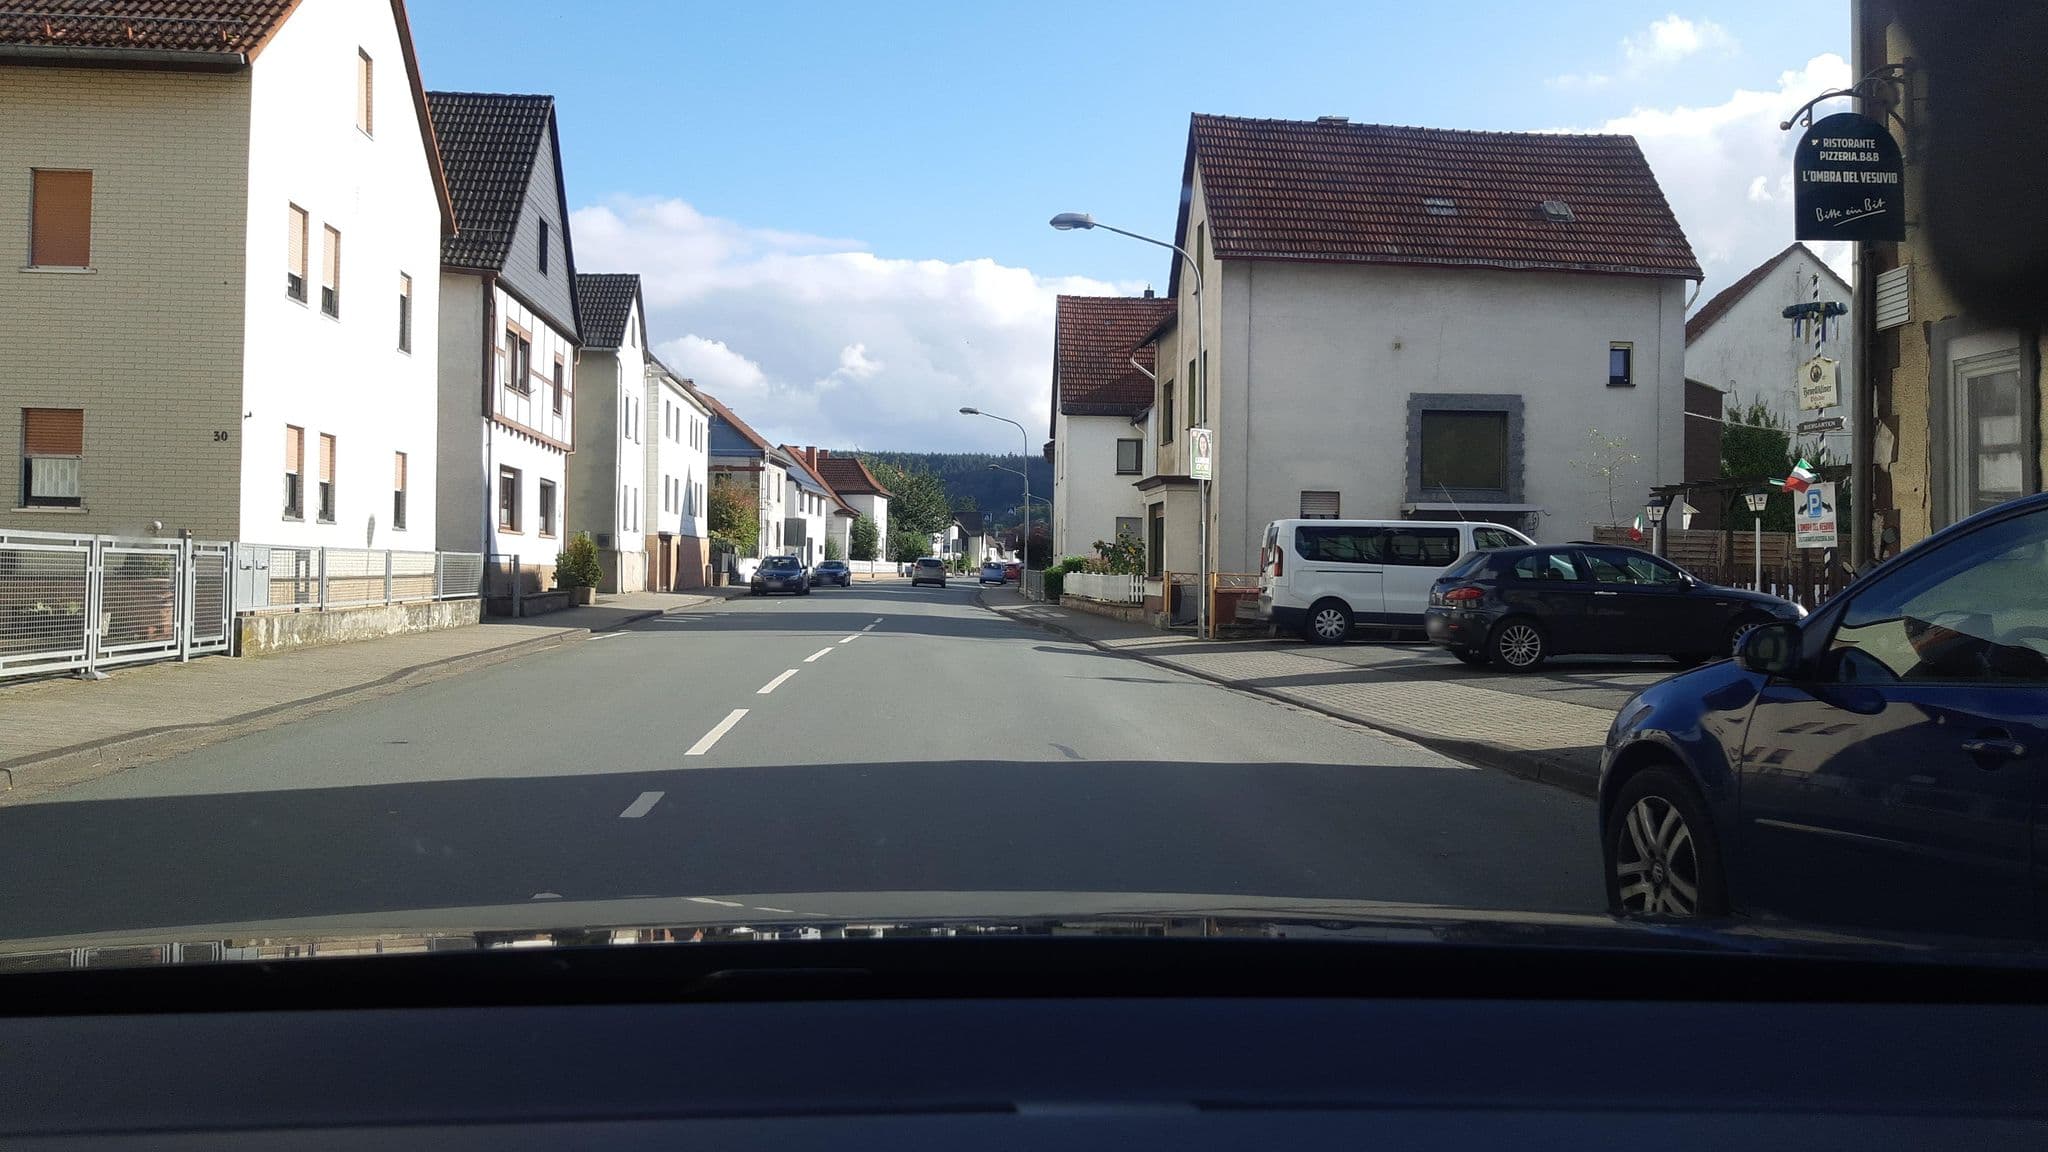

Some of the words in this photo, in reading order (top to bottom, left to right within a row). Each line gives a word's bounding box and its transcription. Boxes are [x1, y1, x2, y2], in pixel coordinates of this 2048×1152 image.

[1823, 138, 1876, 149] RISTORANTE
[1802, 170, 1842, 183] L'OMBRA
[1843, 171, 1859, 183] DEL
[1860, 171, 1898, 184] VESUVIO
[1815, 207, 1842, 222] Bitte
[1846, 206, 1863, 216] ein
[1864, 198, 1886, 211] Bit
[213, 430, 228, 442] 30
[1808, 493, 1820, 515] P
